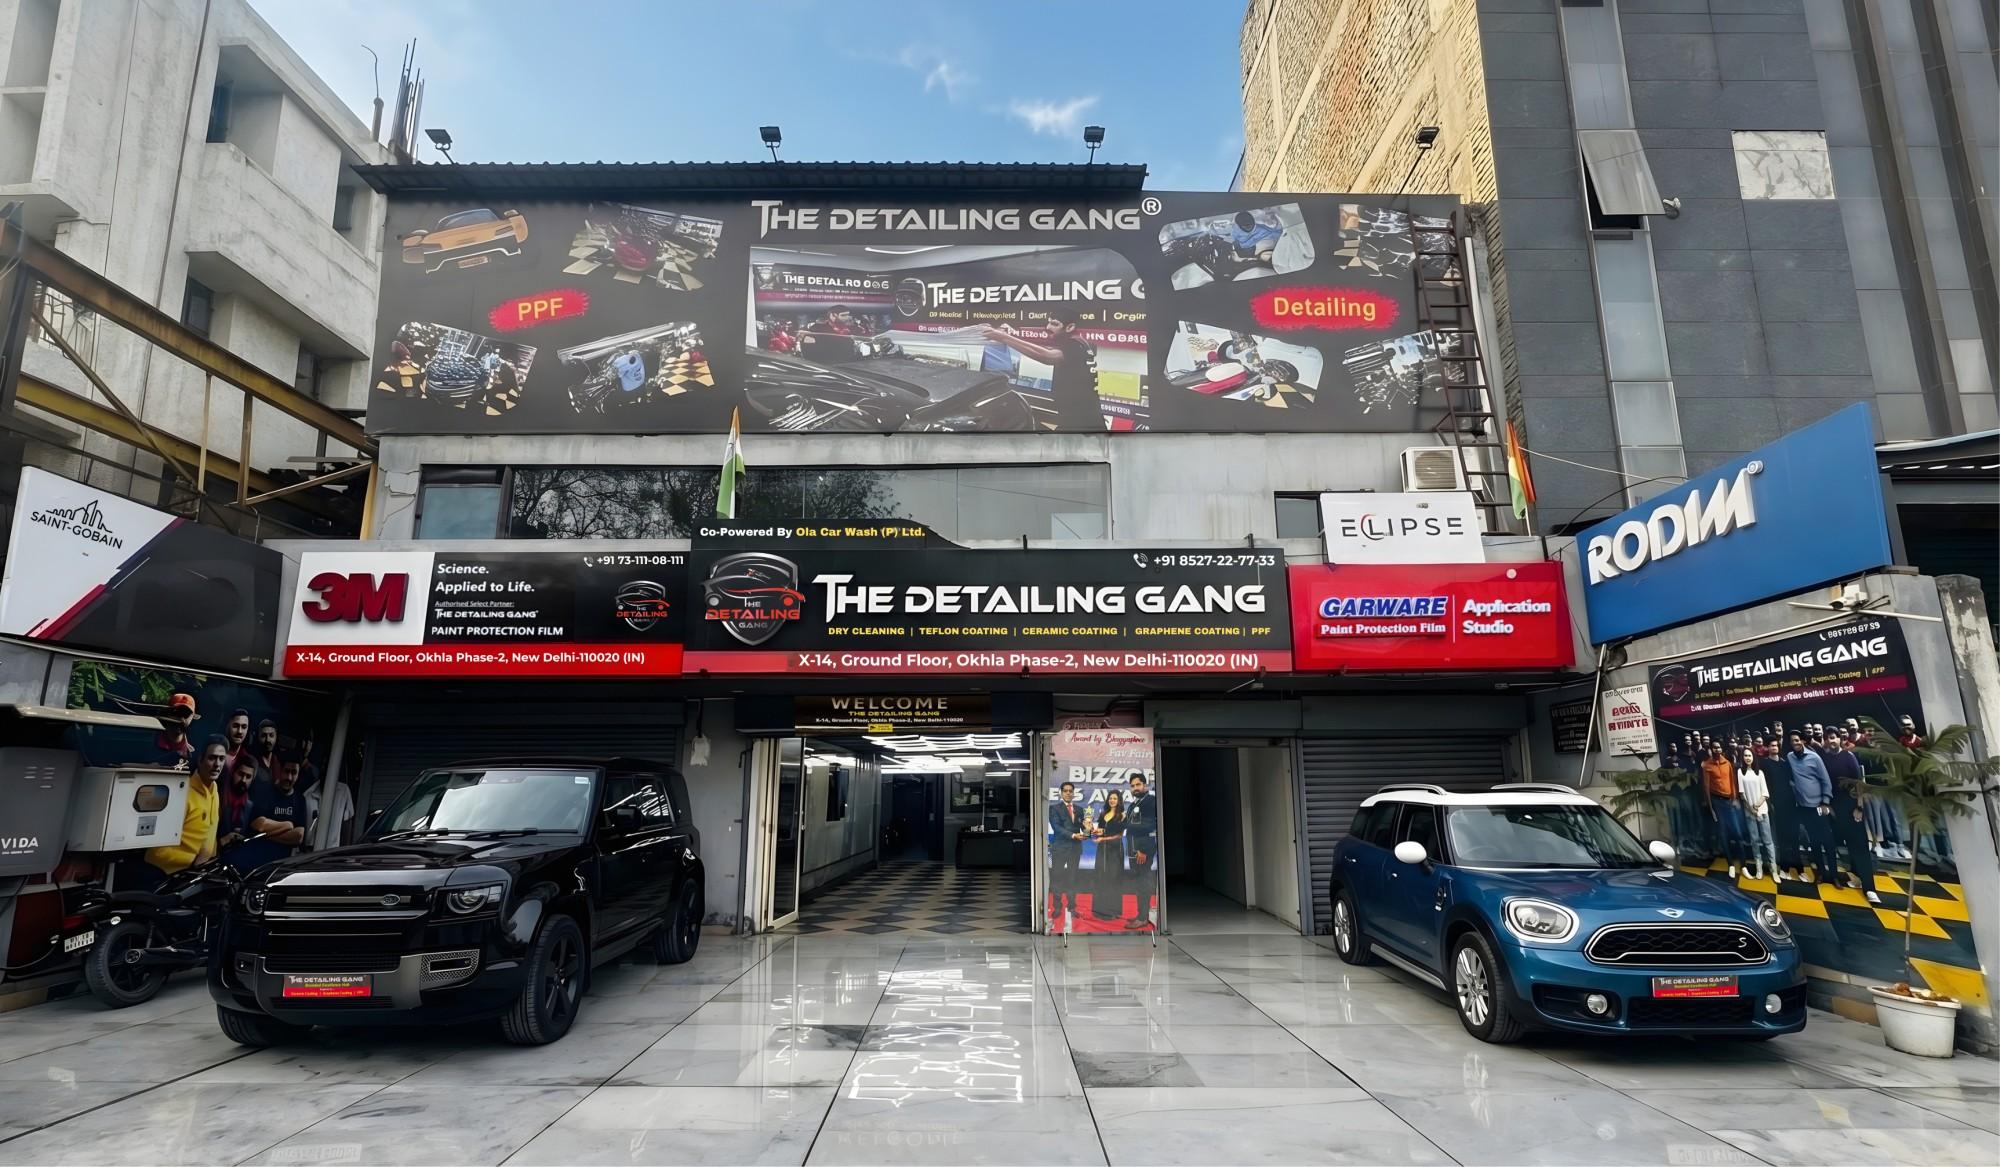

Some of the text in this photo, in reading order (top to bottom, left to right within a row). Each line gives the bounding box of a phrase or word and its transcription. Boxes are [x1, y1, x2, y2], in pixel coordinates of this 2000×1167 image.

[751, 200, 1141, 240] THE DETAILING GANG
[927, 282, 966, 308] THE
[969, 278, 1122, 304] DETAILING
[517, 297, 564, 321] PPF
[1273, 296, 1376, 322] Detailing
[30, 511, 123, 549] SAINT-GOBAIN
[700, 527, 926, 539] Co-Powered By Ola Car Wash (P) Ltd.
[1340, 513, 1464, 540] ECLIPSE
[1587, 467, 1757, 586] RODIM
[597, 556, 684, 565] +91 73-111-08-111
[1153, 555, 1275, 566] +91 8527-22-77-33
[437, 563, 490, 574] Science.
[435, 581, 535, 594] Applied to Life.
[302, 572, 410, 622] 3M
[744, 597, 761, 607] THE
[811, 574, 1266, 623] THE DETAILING GANG
[1319, 596, 1448, 618] GARWARE
[1463, 599, 1551, 614] Application
[434, 608, 453, 620] THE
[506, 610, 537, 618] GANG
[705, 608, 801, 620] DETAILING
[431, 626, 564, 636] PAINT PROTECTION FILM
[828, 627, 1272, 635] DRY CLEANING TEFLON COATING CERAMIC COATING GRAPHENE COATING PPF
[1321, 623, 1446, 635] Paint Protection Film
[1463, 620, 1514, 635] Studio
[296, 652, 645, 665] X-14, Ground Floor, Okhla Phase-2, New Delhi-110020 (IN)
[798, 653, 1258, 669] X-14, Ground Floor, Okhla Phase-2, New Delhi-110020 (IN)
[1690, 665, 1719, 688] THE
[1722, 650, 1814, 681] DETAILING
[1816, 635, 1888, 664] GANG
[831, 697, 948, 709] WELCOME
[1071, 732, 1092, 743] Award
[1093, 735, 1102, 746] by
[1, 837, 39, 849] VIDA
[1738, 937, 1747, 948] S
[288, 975, 303, 984] THE
[1659, 977, 1672, 986] THE
